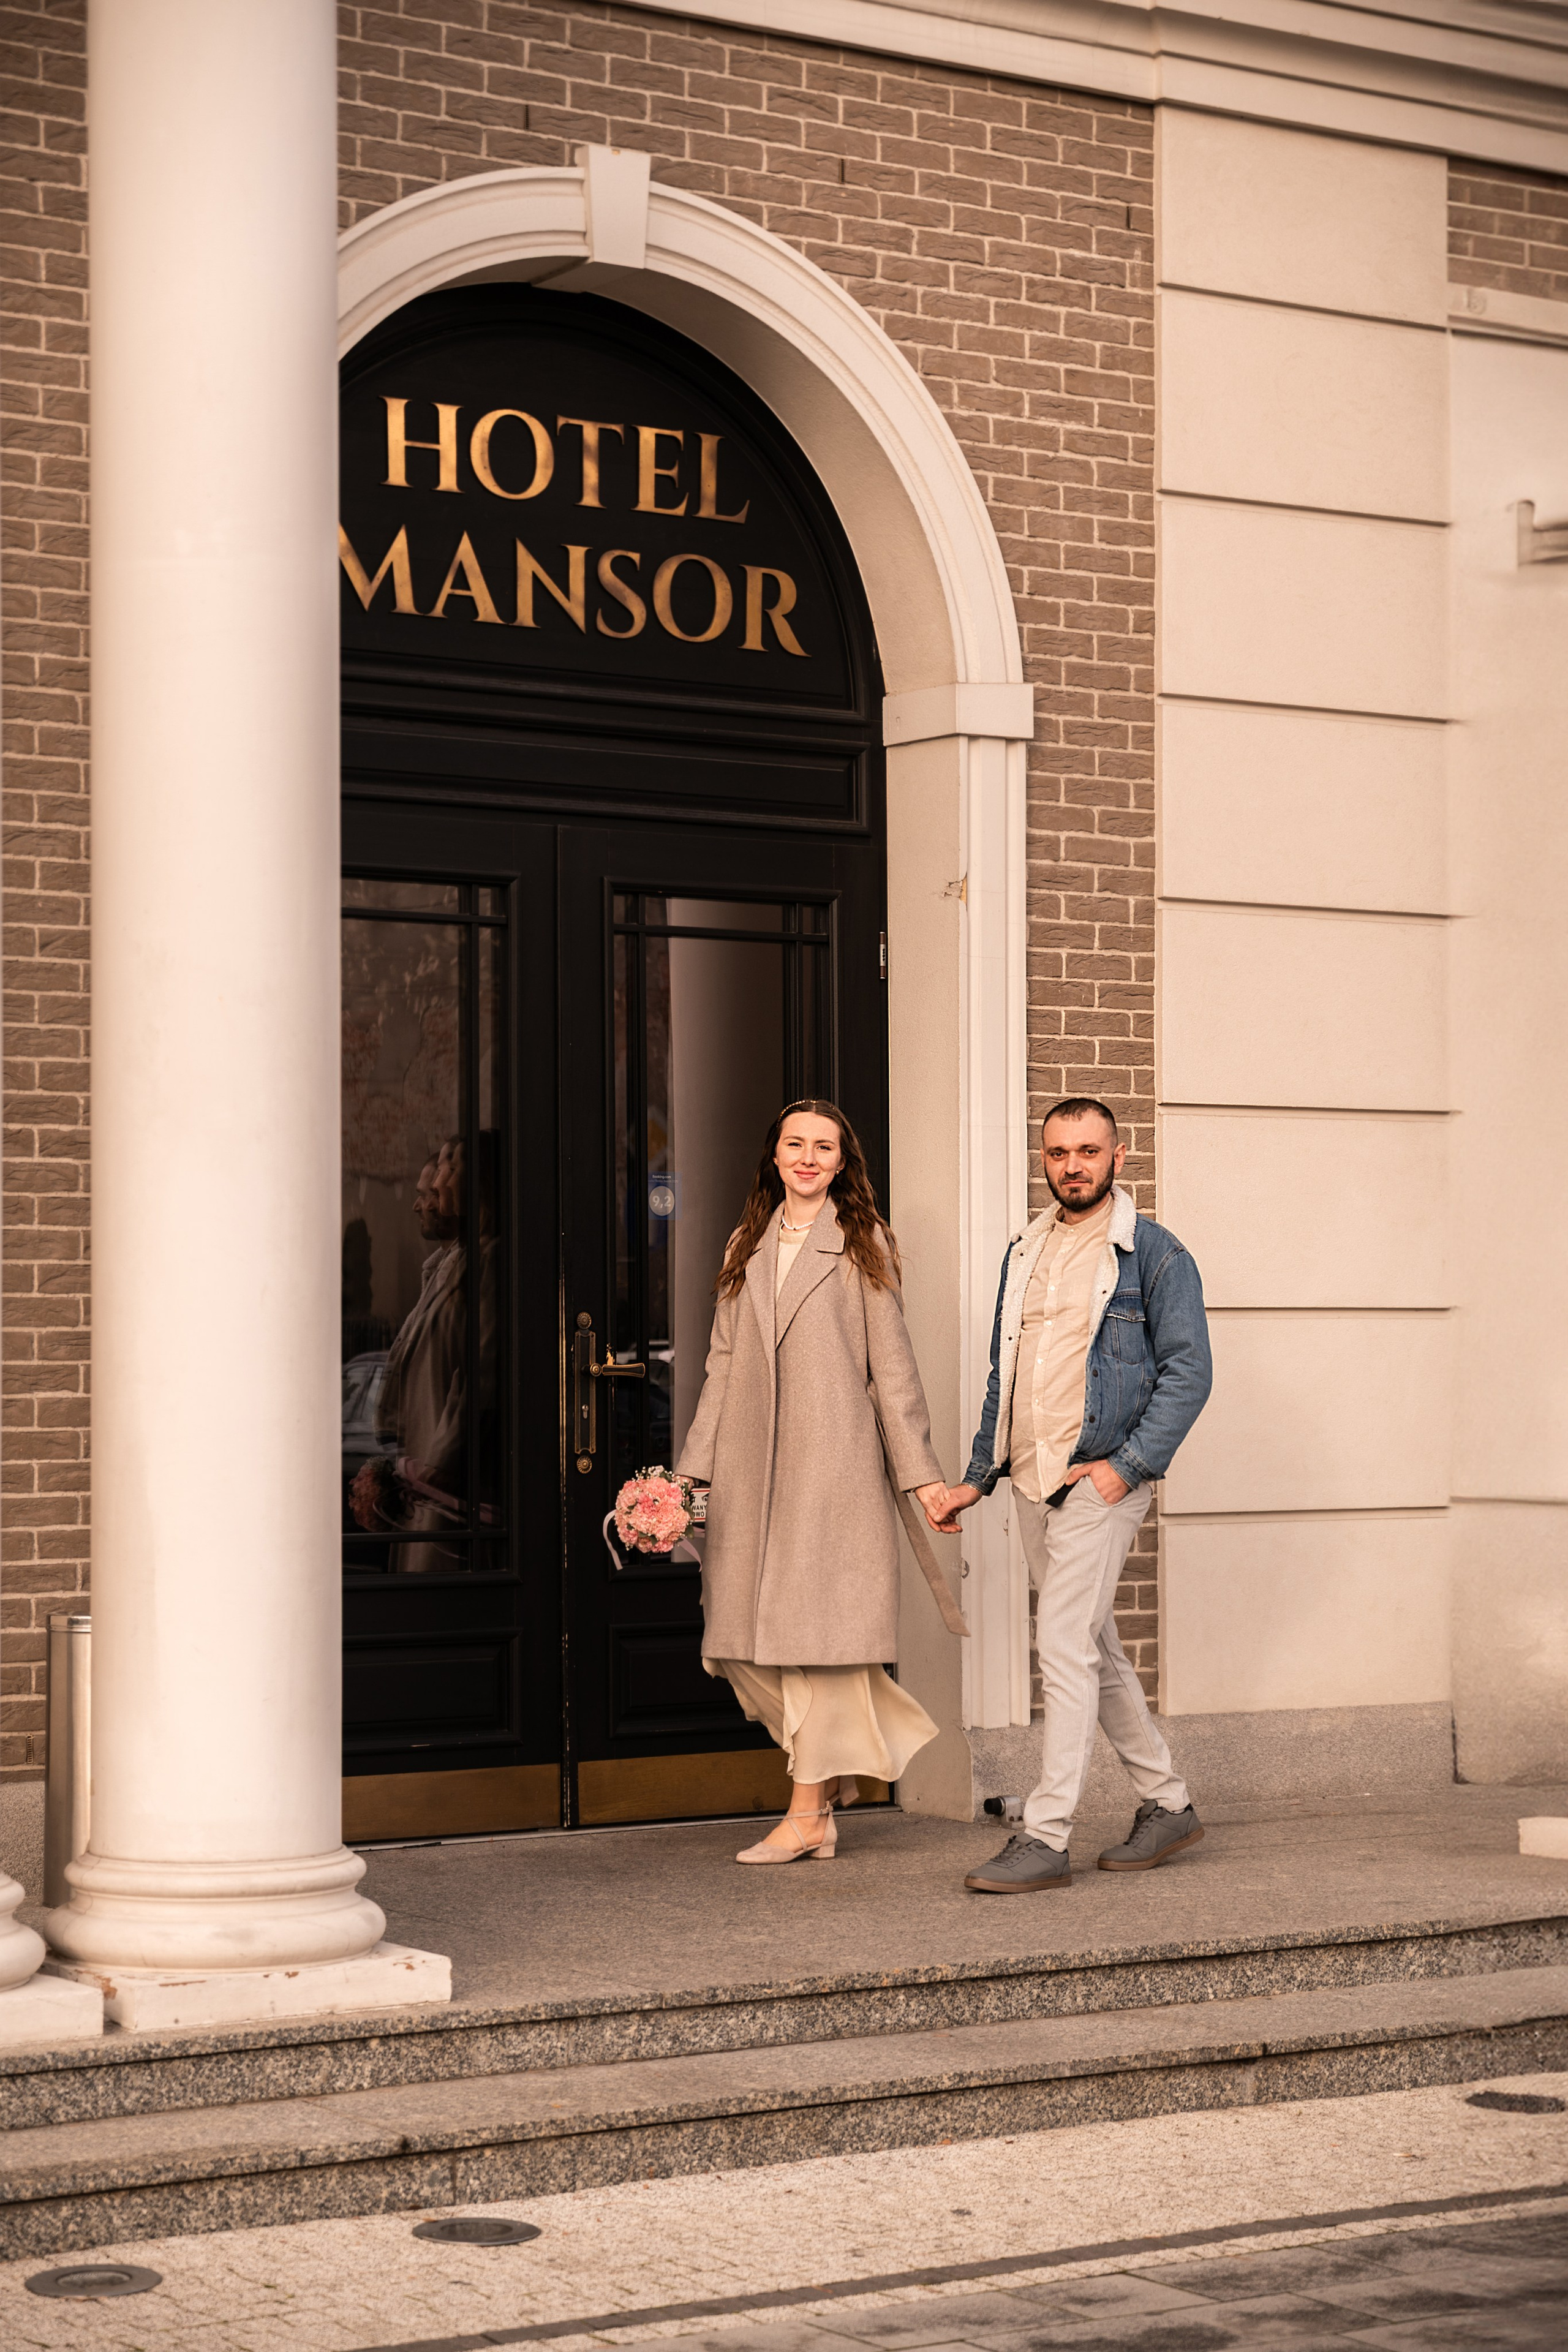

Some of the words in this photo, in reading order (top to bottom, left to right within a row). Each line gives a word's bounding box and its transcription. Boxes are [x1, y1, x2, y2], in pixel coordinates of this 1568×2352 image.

[379, 396, 750, 524] HOTEL
[339, 522, 811, 657] MANSOR
[652, 1196, 671, 1208] 9,2
